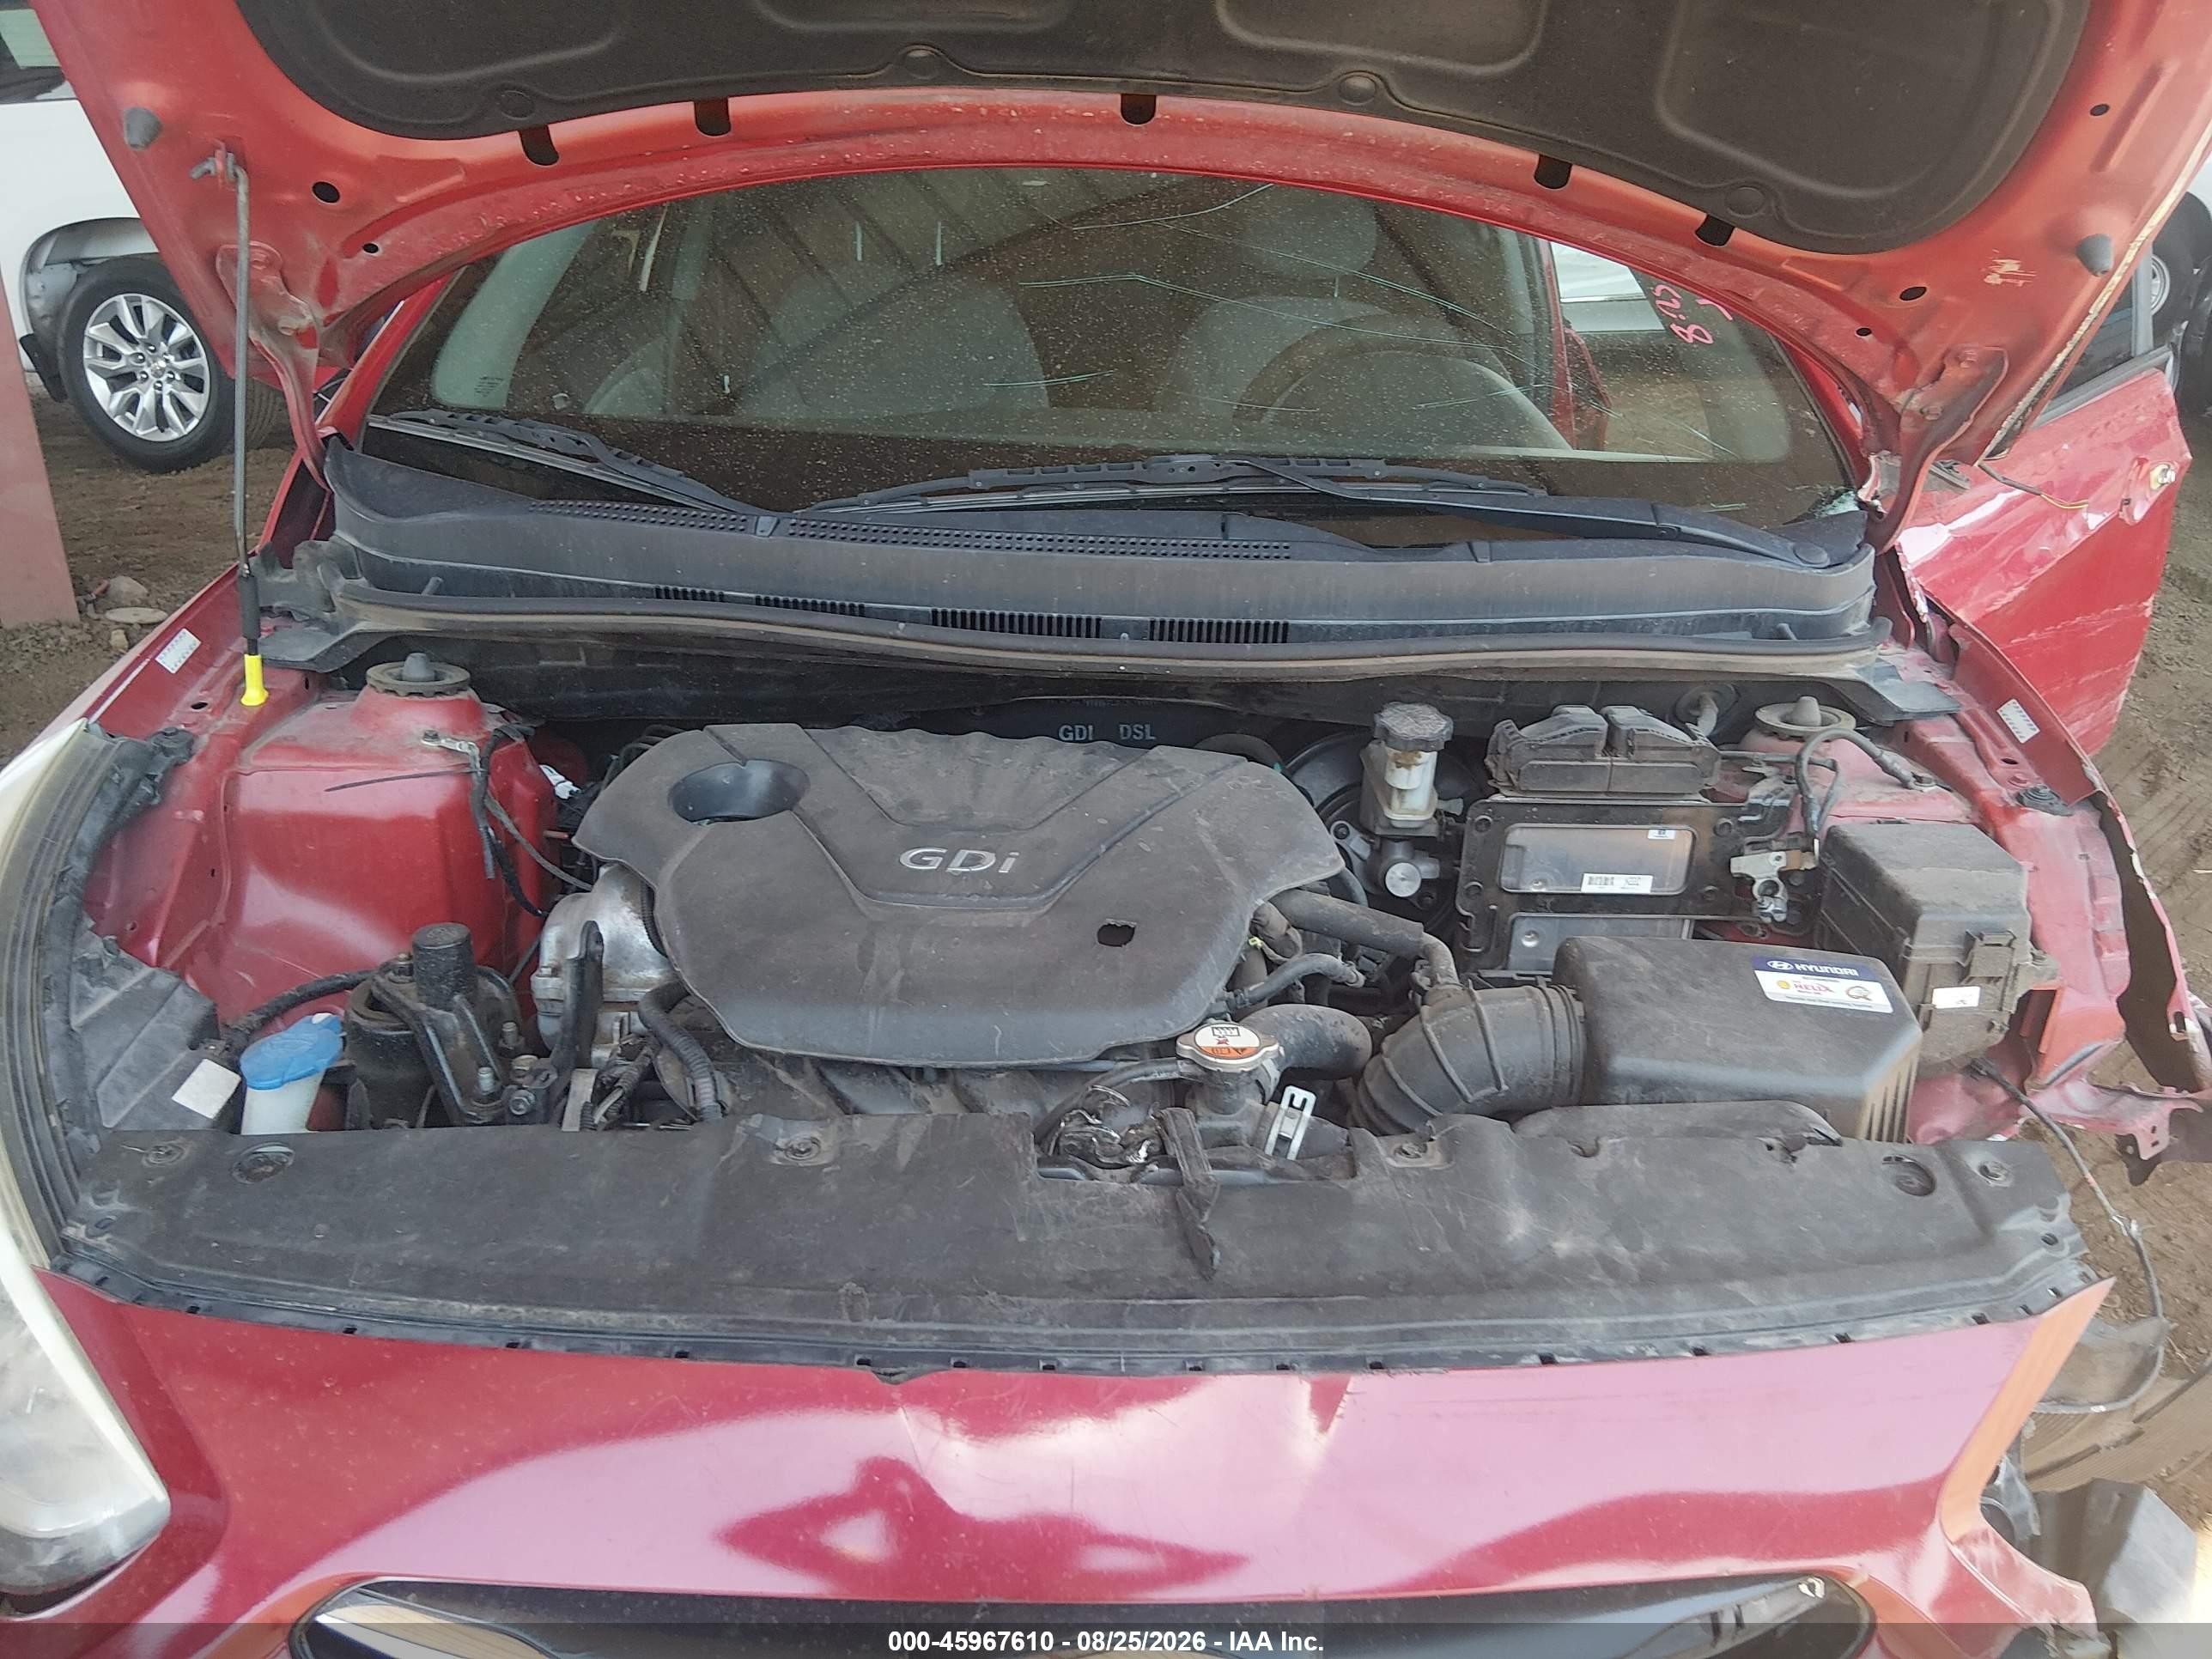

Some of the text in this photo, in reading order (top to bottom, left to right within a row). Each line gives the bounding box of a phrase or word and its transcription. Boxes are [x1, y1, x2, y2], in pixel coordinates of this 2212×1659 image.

[1058, 724, 1157, 741] GDI DSL
[899, 847, 1020, 873] GDi
[1794, 963, 1859, 976] HYUNDAI
